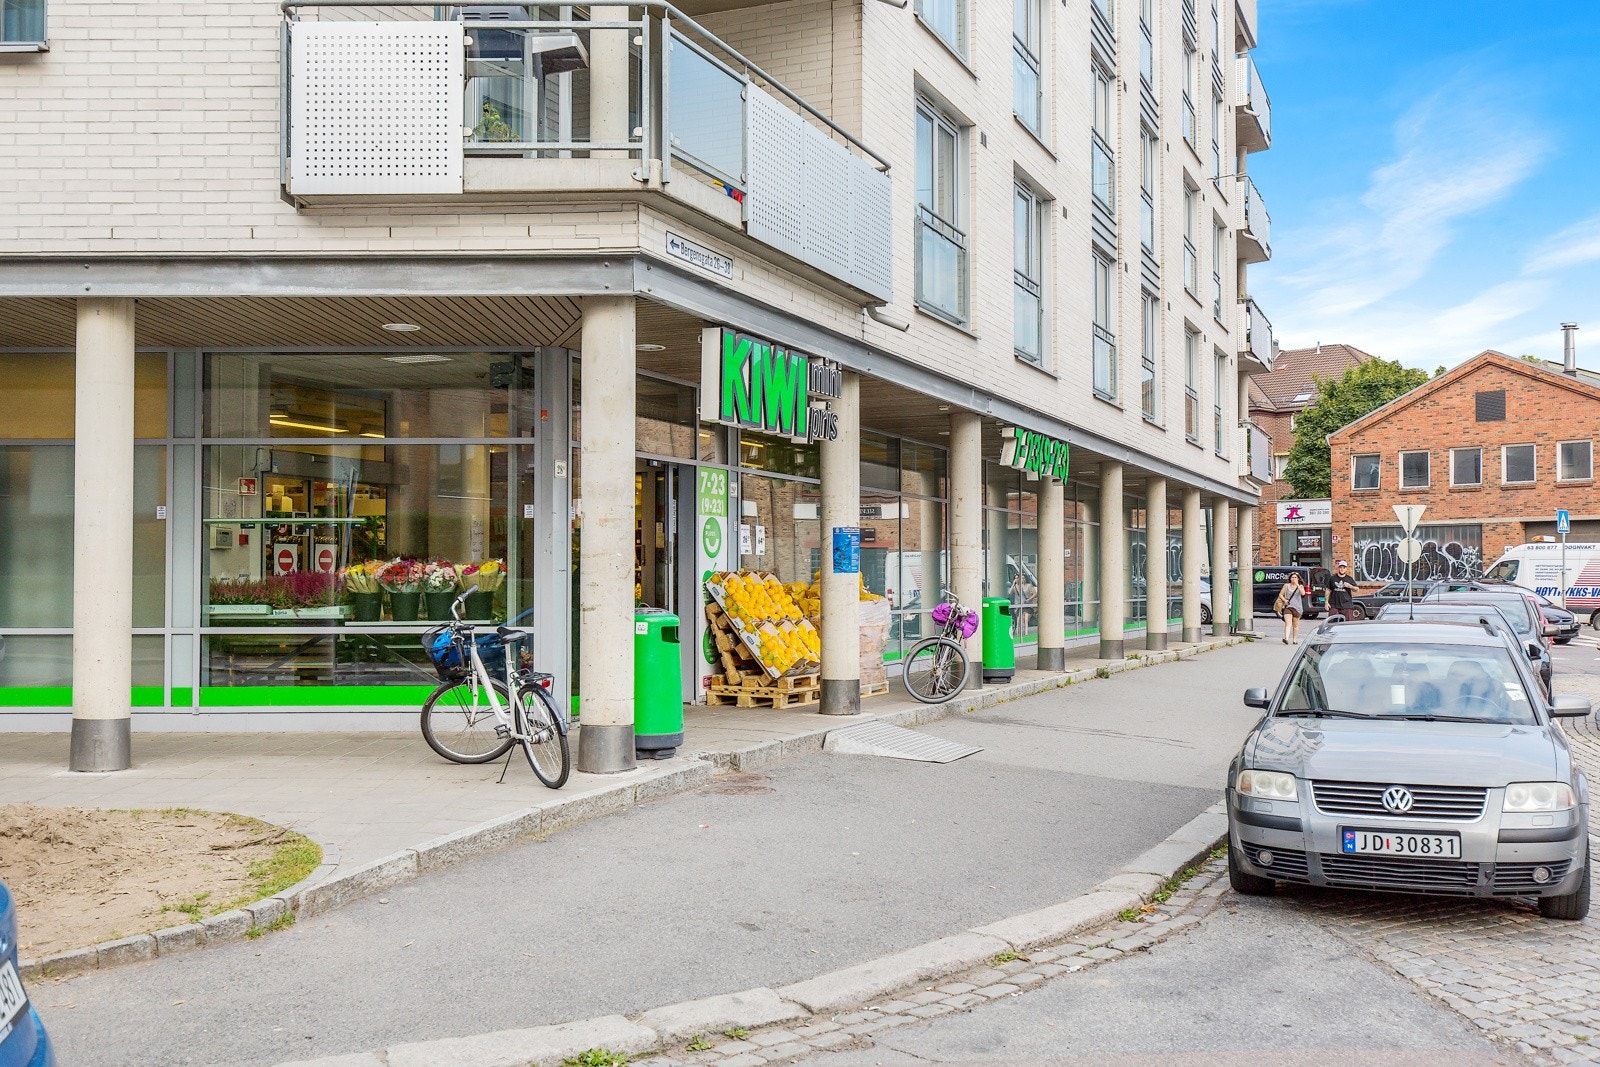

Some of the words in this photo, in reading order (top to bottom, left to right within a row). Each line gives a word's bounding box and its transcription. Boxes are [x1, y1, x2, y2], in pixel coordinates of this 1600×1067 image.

[721, 328, 808, 438] KIWI
[808, 357, 842, 398] mini
[808, 402, 838, 444] pris
[700, 471, 725, 496] 7-23
[701, 498, 724, 515] (9-23)
[1360, 834, 1383, 851] JD
[1395, 836, 1455, 855] 30831
